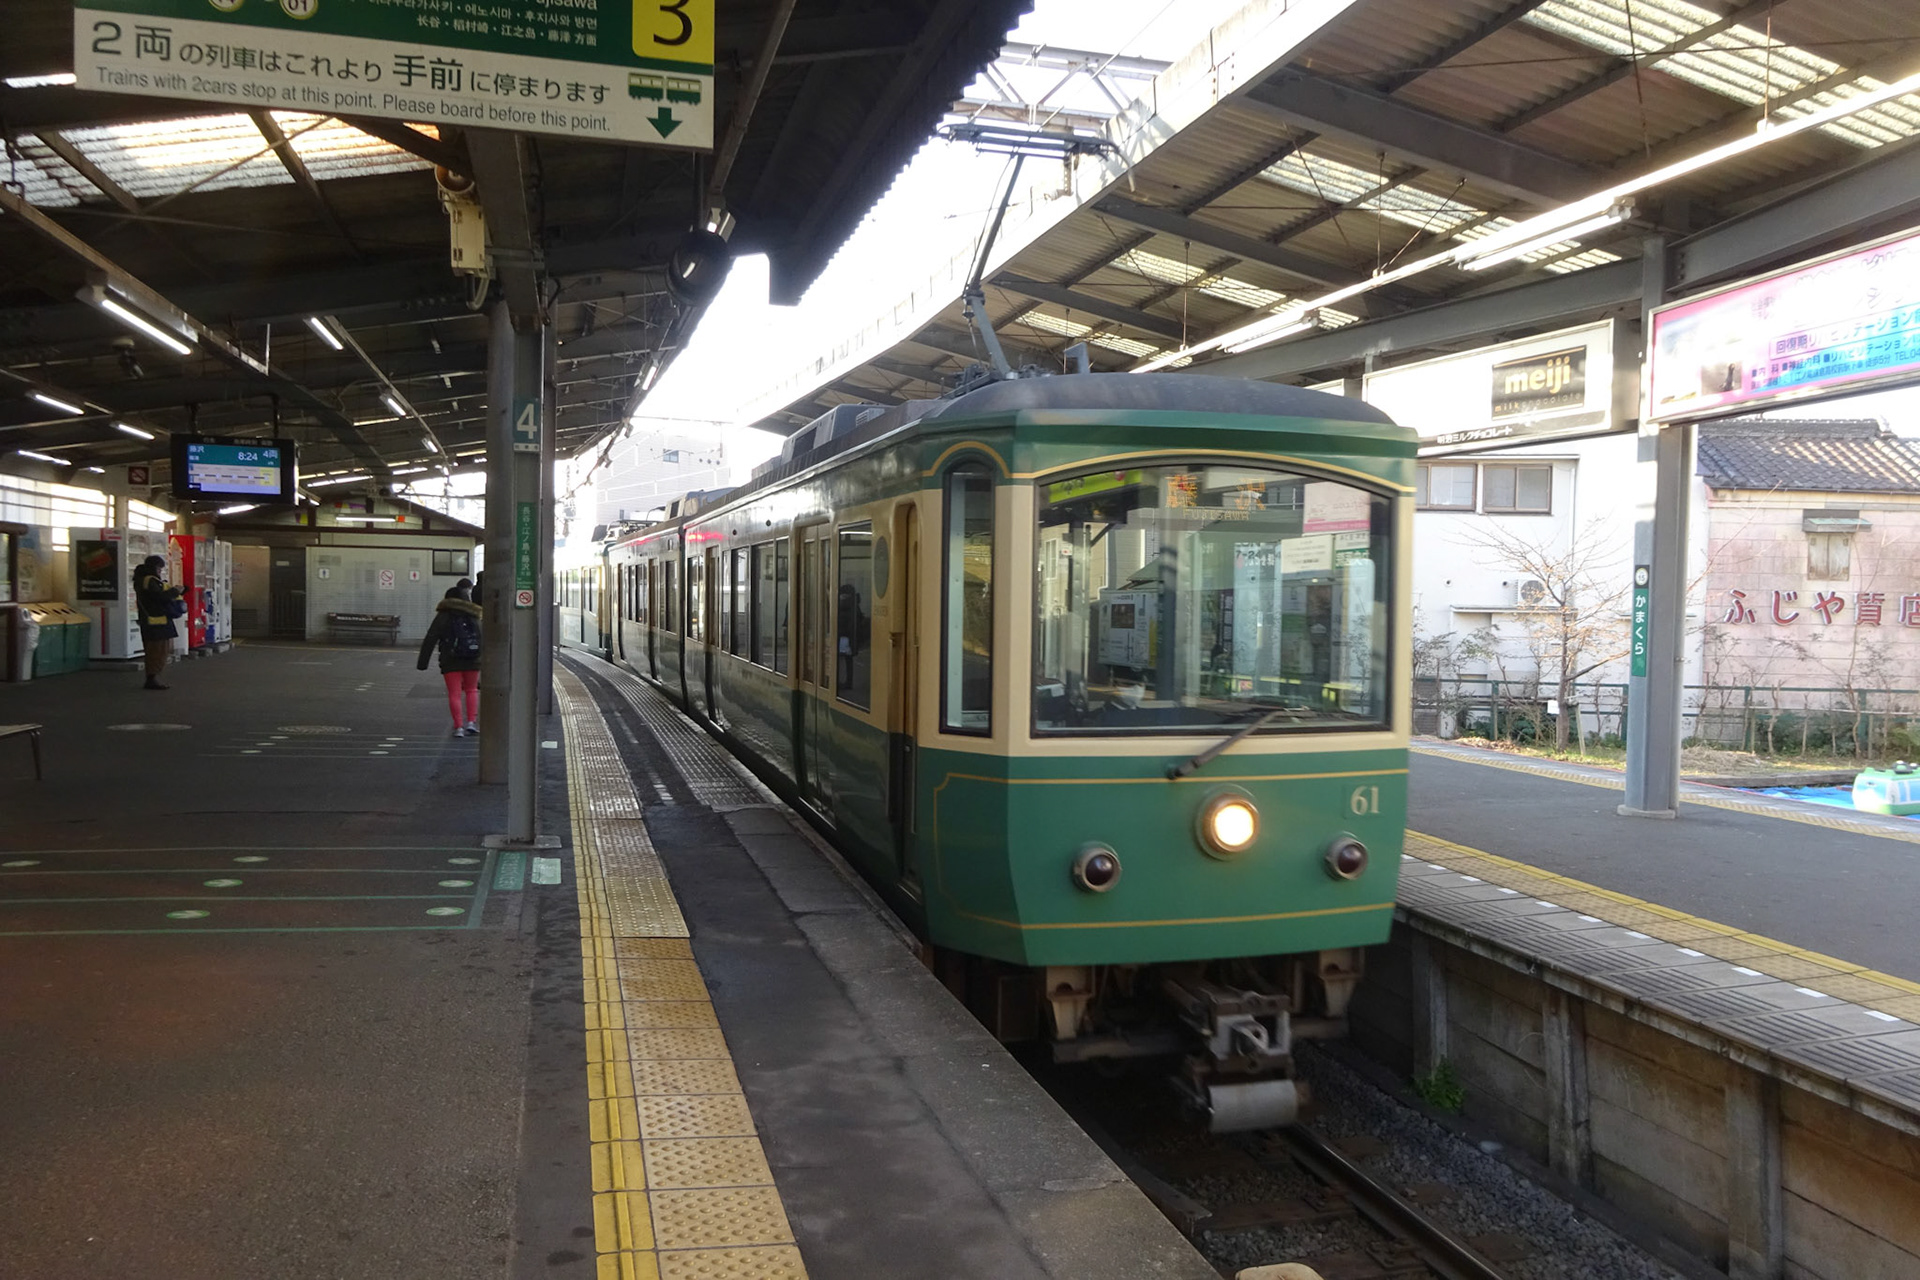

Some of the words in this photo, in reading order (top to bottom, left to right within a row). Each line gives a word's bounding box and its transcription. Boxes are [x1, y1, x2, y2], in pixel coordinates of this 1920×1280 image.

[652, 0, 693, 46] 3
[96, 66, 148, 88] Trains
[153, 73, 187, 91] with
[192, 76, 237, 96] 2cars
[242, 82, 276, 100] stop
[281, 87, 296, 101] at
[302, 86, 330, 104] this
[334, 91, 377, 109] point.
[383, 94, 435, 114] Please
[440, 100, 484, 119] board
[489, 105, 537, 124] before
[541, 110, 567, 127] this
[571, 114, 611, 131] point.
[1504, 356, 1571, 394] meiji
[517, 403, 538, 440] 4
[1494, 402, 1520, 413] milk
[237, 451, 259, 461] 8:24
[1182, 508, 1251, 521] FUJISAWA
[1634, 595, 1646, 655] かまくら
[1724, 589, 1920, 627] ふじや質店
[1350, 785, 1381, 816] 61
